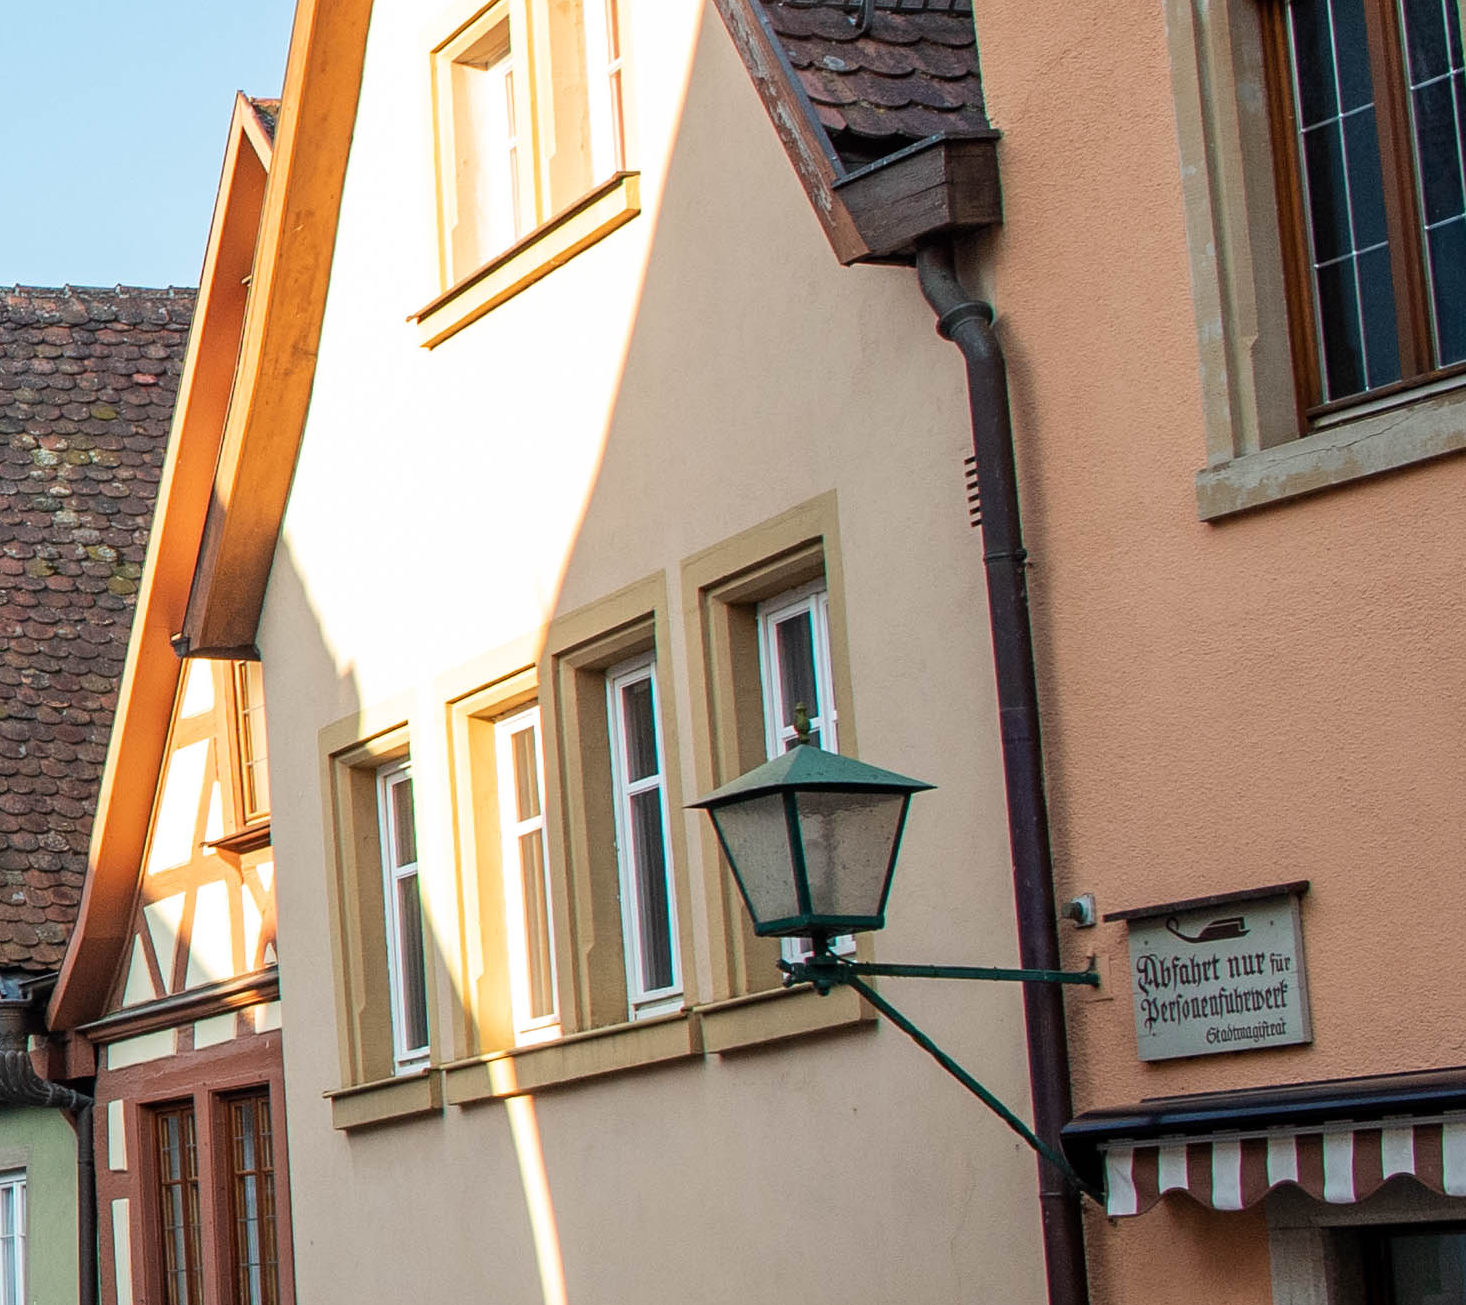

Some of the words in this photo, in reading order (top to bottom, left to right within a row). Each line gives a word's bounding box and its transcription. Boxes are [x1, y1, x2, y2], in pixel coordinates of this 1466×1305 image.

[1137, 953, 1220, 995] Abfahrt
[1227, 952, 1265, 979] nur
[1269, 952, 1290, 975] für
